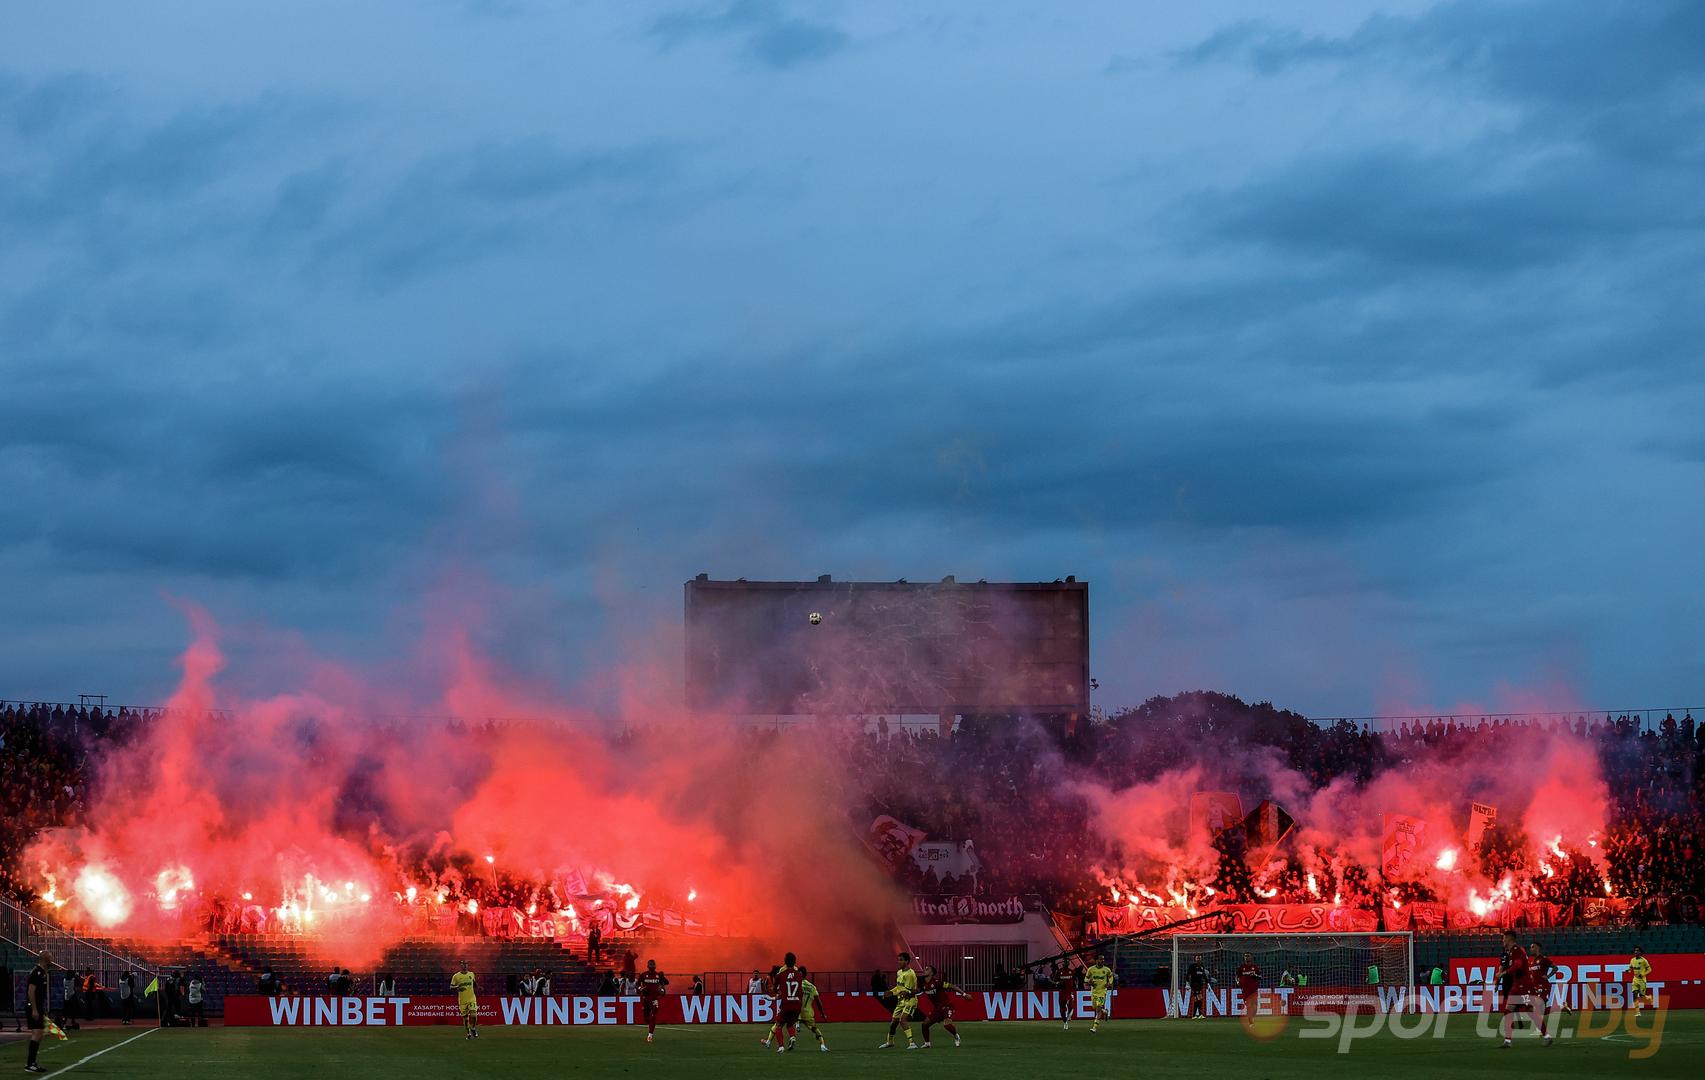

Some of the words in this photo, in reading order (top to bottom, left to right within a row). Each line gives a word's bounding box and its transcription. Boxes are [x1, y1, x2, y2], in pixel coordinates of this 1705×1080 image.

[979, 896, 1023, 921] north
[1456, 964, 1630, 984] WBET
[785, 981, 799, 996] 17
[1162, 988, 1295, 1016] WNBET
[268, 996, 411, 1026] WINBET
[500, 996, 641, 1025] WINBET
[680, 995, 782, 1023] WINB
